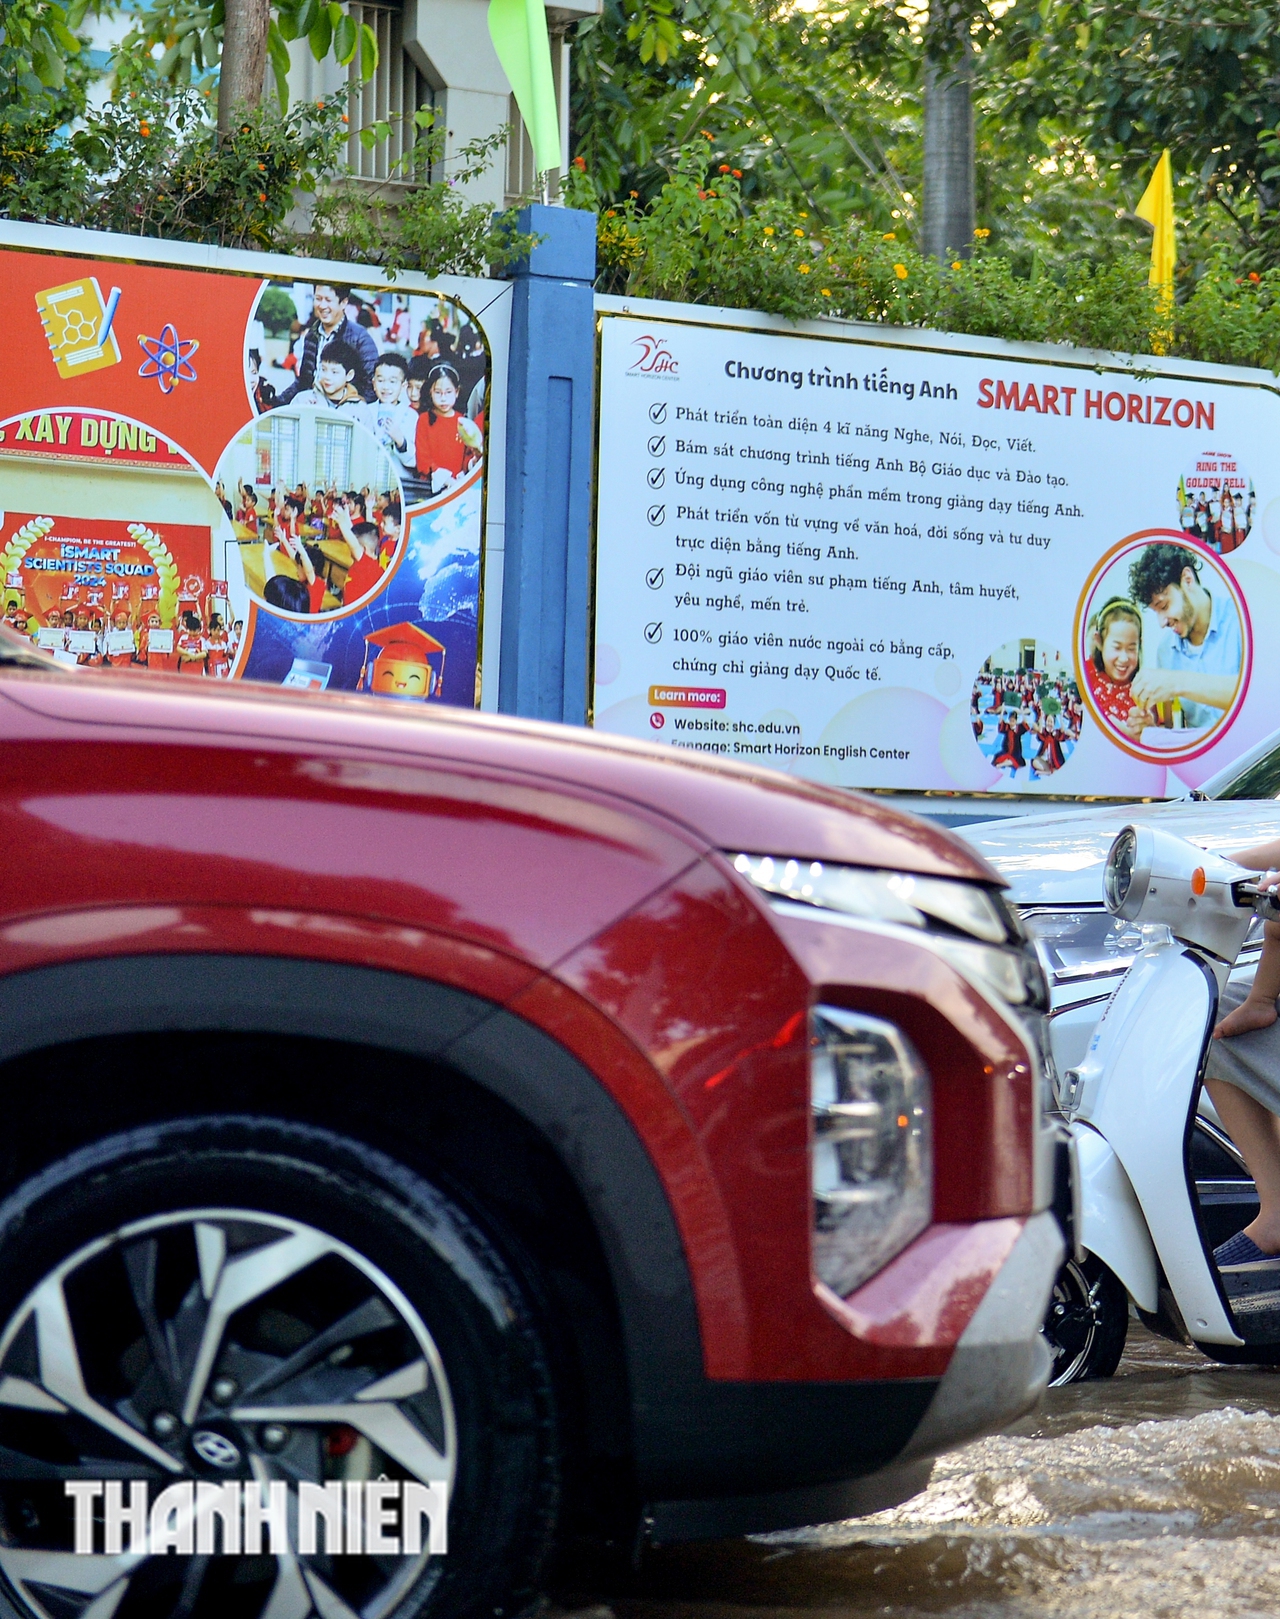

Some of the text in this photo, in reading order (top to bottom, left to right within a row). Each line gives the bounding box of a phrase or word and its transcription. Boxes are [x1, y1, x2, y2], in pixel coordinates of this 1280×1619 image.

[724, 359, 1215, 430] Chương trình tiếng Anh SMART HORIZON
[675, 406, 1036, 453] Phát triển toàn diện 4 kĩ năng Nghe, Nói, Đọc, Viết.
[675, 439, 1069, 489] Bám sát chương trình tiếng Anh Bộ Giáo dục và Đào tạo.
[1196, 462, 1236, 472] RING THE
[674, 466, 705, 490] Ứng
[709, 474, 746, 494] dụng
[750, 477, 785, 497] công
[789, 481, 824, 500] nghệ
[906, 491, 943, 510] trong
[946, 493, 984, 513] giảng
[988, 497, 1013, 515] dạy
[1017, 499, 1050, 519] tiếng
[1054, 503, 1085, 518] Anh.
[1186, 477, 1221, 488] GOLDEN
[676, 505, 710, 521] Phát
[714, 507, 749, 524] triển
[753, 510, 780, 526] vốn
[784, 513, 799, 528] từ
[803, 518, 839, 535] vựng
[864, 520, 890, 535] văn
[893, 522, 922, 540] hoá,
[926, 524, 948, 540] đời
[952, 526, 985, 546] sống
[988, 529, 1005, 544] và
[1009, 532, 1023, 545] tư
[1026, 533, 1052, 550] duy
[60, 543, 121, 561] iSMART
[675, 534, 705, 552] trực
[710, 536, 741, 555] diện
[786, 541, 822, 562] tiếng
[826, 545, 859, 561] Anh.
[24, 556, 155, 577] SCIENTISTS SQUAD
[73, 574, 107, 587] 2024
[675, 562, 1020, 601] Đội ngũ giáo viên sư phạm tiếng Anh, tâm huyết,
[674, 591, 701, 609] yêu
[750, 596, 781, 612] mến
[786, 599, 809, 613] trẻ.
[673, 628, 713, 644] 100%
[718, 630, 749, 648] giáo
[753, 632, 784, 647] viên
[788, 634, 822, 650] nước
[826, 637, 865, 655] ngoài
[869, 639, 885, 654] có
[927, 642, 955, 660] cấp,
[672, 657, 881, 682] chứng chỉ giảng dạy Quốc tế.
[654, 689, 721, 703] Learn more:
[674, 718, 801, 735] Website: shc.edu.vn
[733, 741, 772, 755] Smart
[774, 742, 821, 756] Horizon
[823, 744, 867, 761] English
[869, 747, 911, 760] Center
